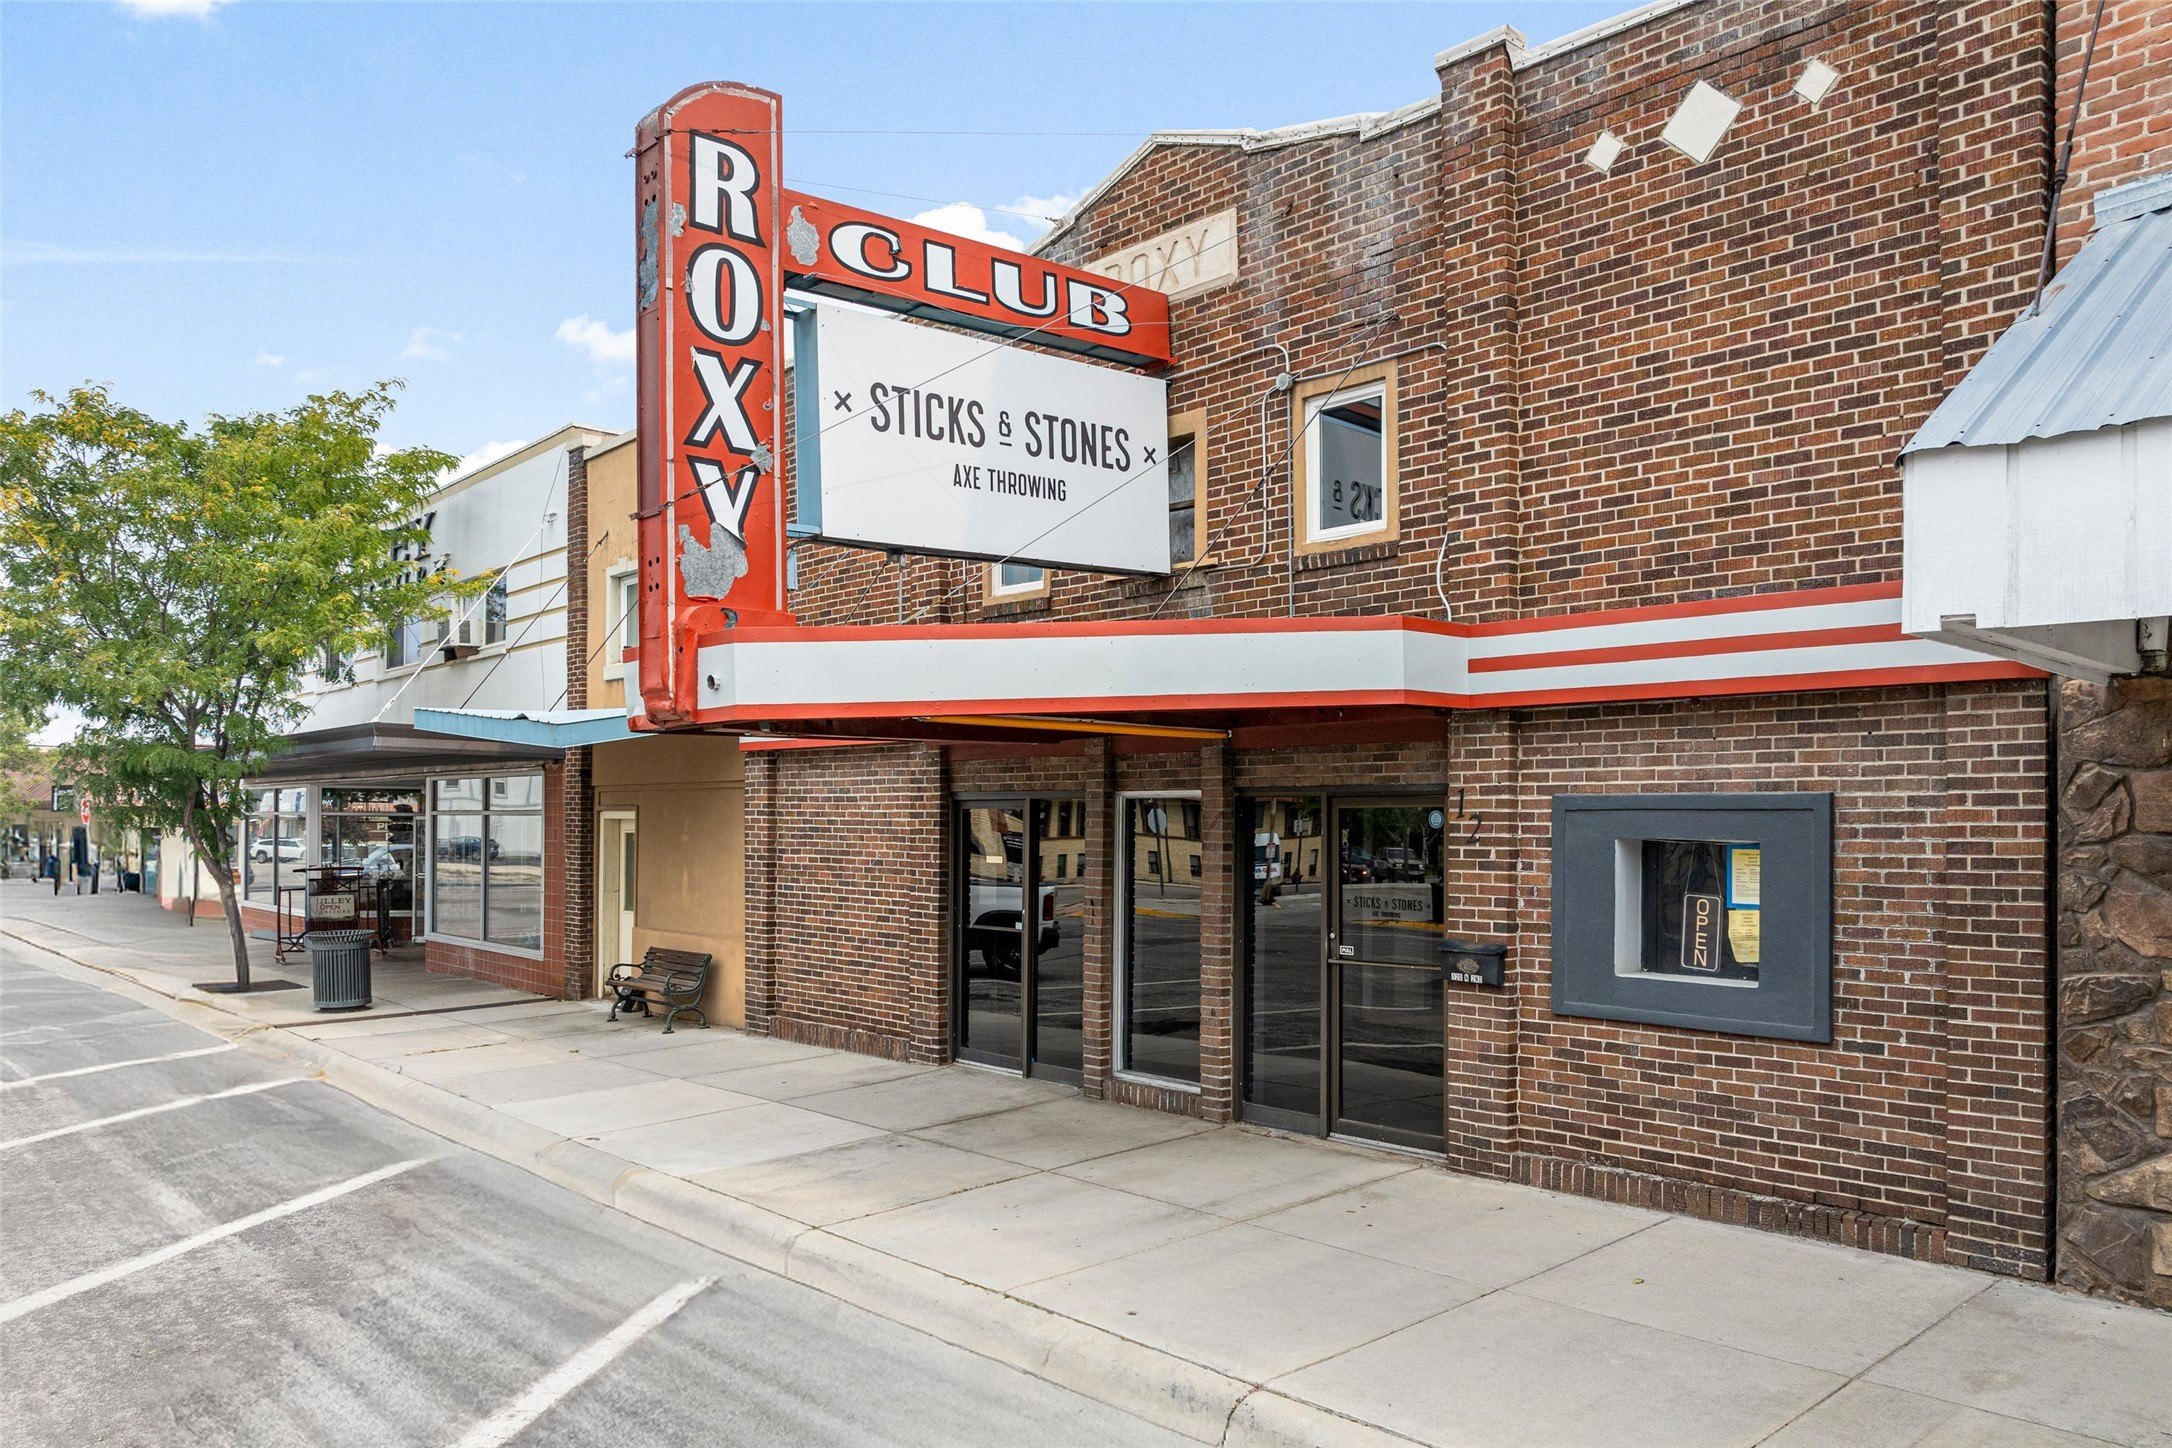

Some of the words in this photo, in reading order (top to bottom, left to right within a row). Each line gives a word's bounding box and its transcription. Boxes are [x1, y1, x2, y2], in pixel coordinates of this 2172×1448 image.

[828, 221, 1132, 338] CLUB
[684, 129, 766, 549] ROXY
[870, 382, 985, 448] STICKS
[999, 410, 1012, 446] &
[1025, 411, 1131, 472] STONES
[953, 464, 981, 490] AXE
[988, 468, 1067, 502] THROWING
[1353, 896, 1381, 909] STICKS
[1392, 898, 1423, 912] STONES
[1694, 898, 1710, 967] OPEN
